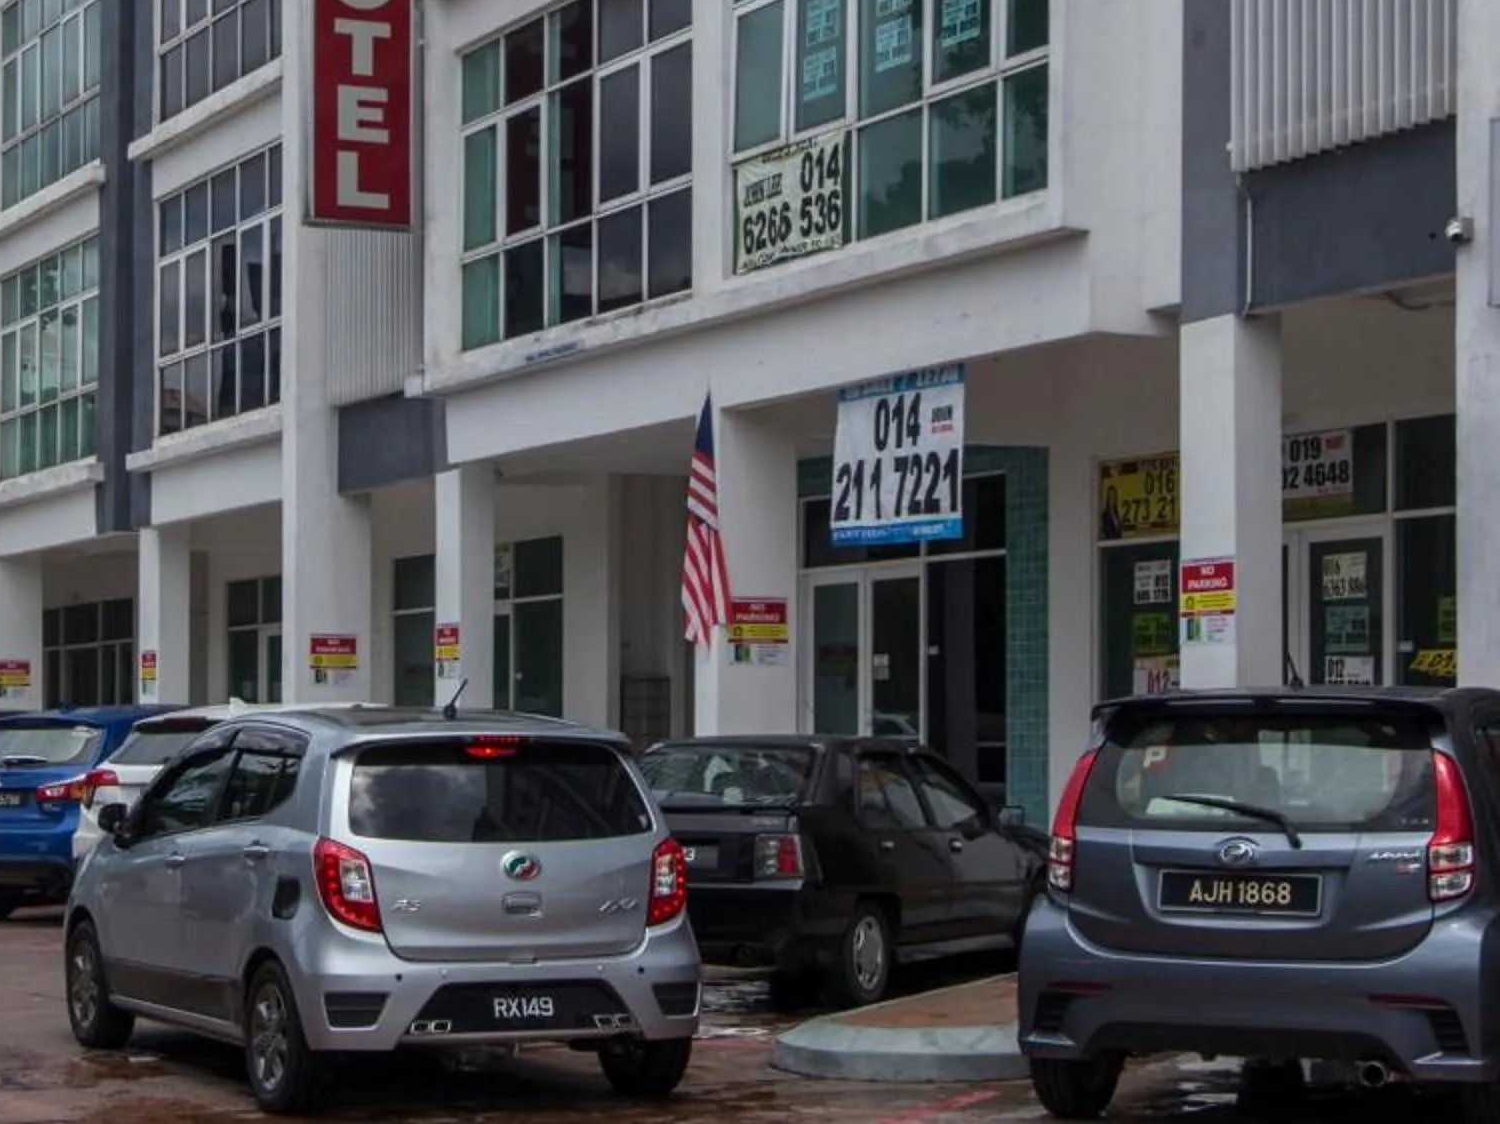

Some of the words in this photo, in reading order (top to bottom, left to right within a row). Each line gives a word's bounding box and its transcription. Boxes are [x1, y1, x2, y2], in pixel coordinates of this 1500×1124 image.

[800, 143, 841, 193] 014
[800, 189, 841, 237] 536
[874, 392, 921, 452] 014
[1289, 436, 1322, 463] 019
[833, 457, 882, 522] 211
[893, 448, 960, 517] 7221
[1303, 459, 1350, 488] 4648
[1122, 498, 1150, 524] 273
[1187, 576, 1229, 590] PARKING
[1200, 565, 1216, 576] NO
[1143, 746, 1167, 769] P
[1188, 879, 1233, 903] AJH
[1238, 881, 1291, 905] 1868
